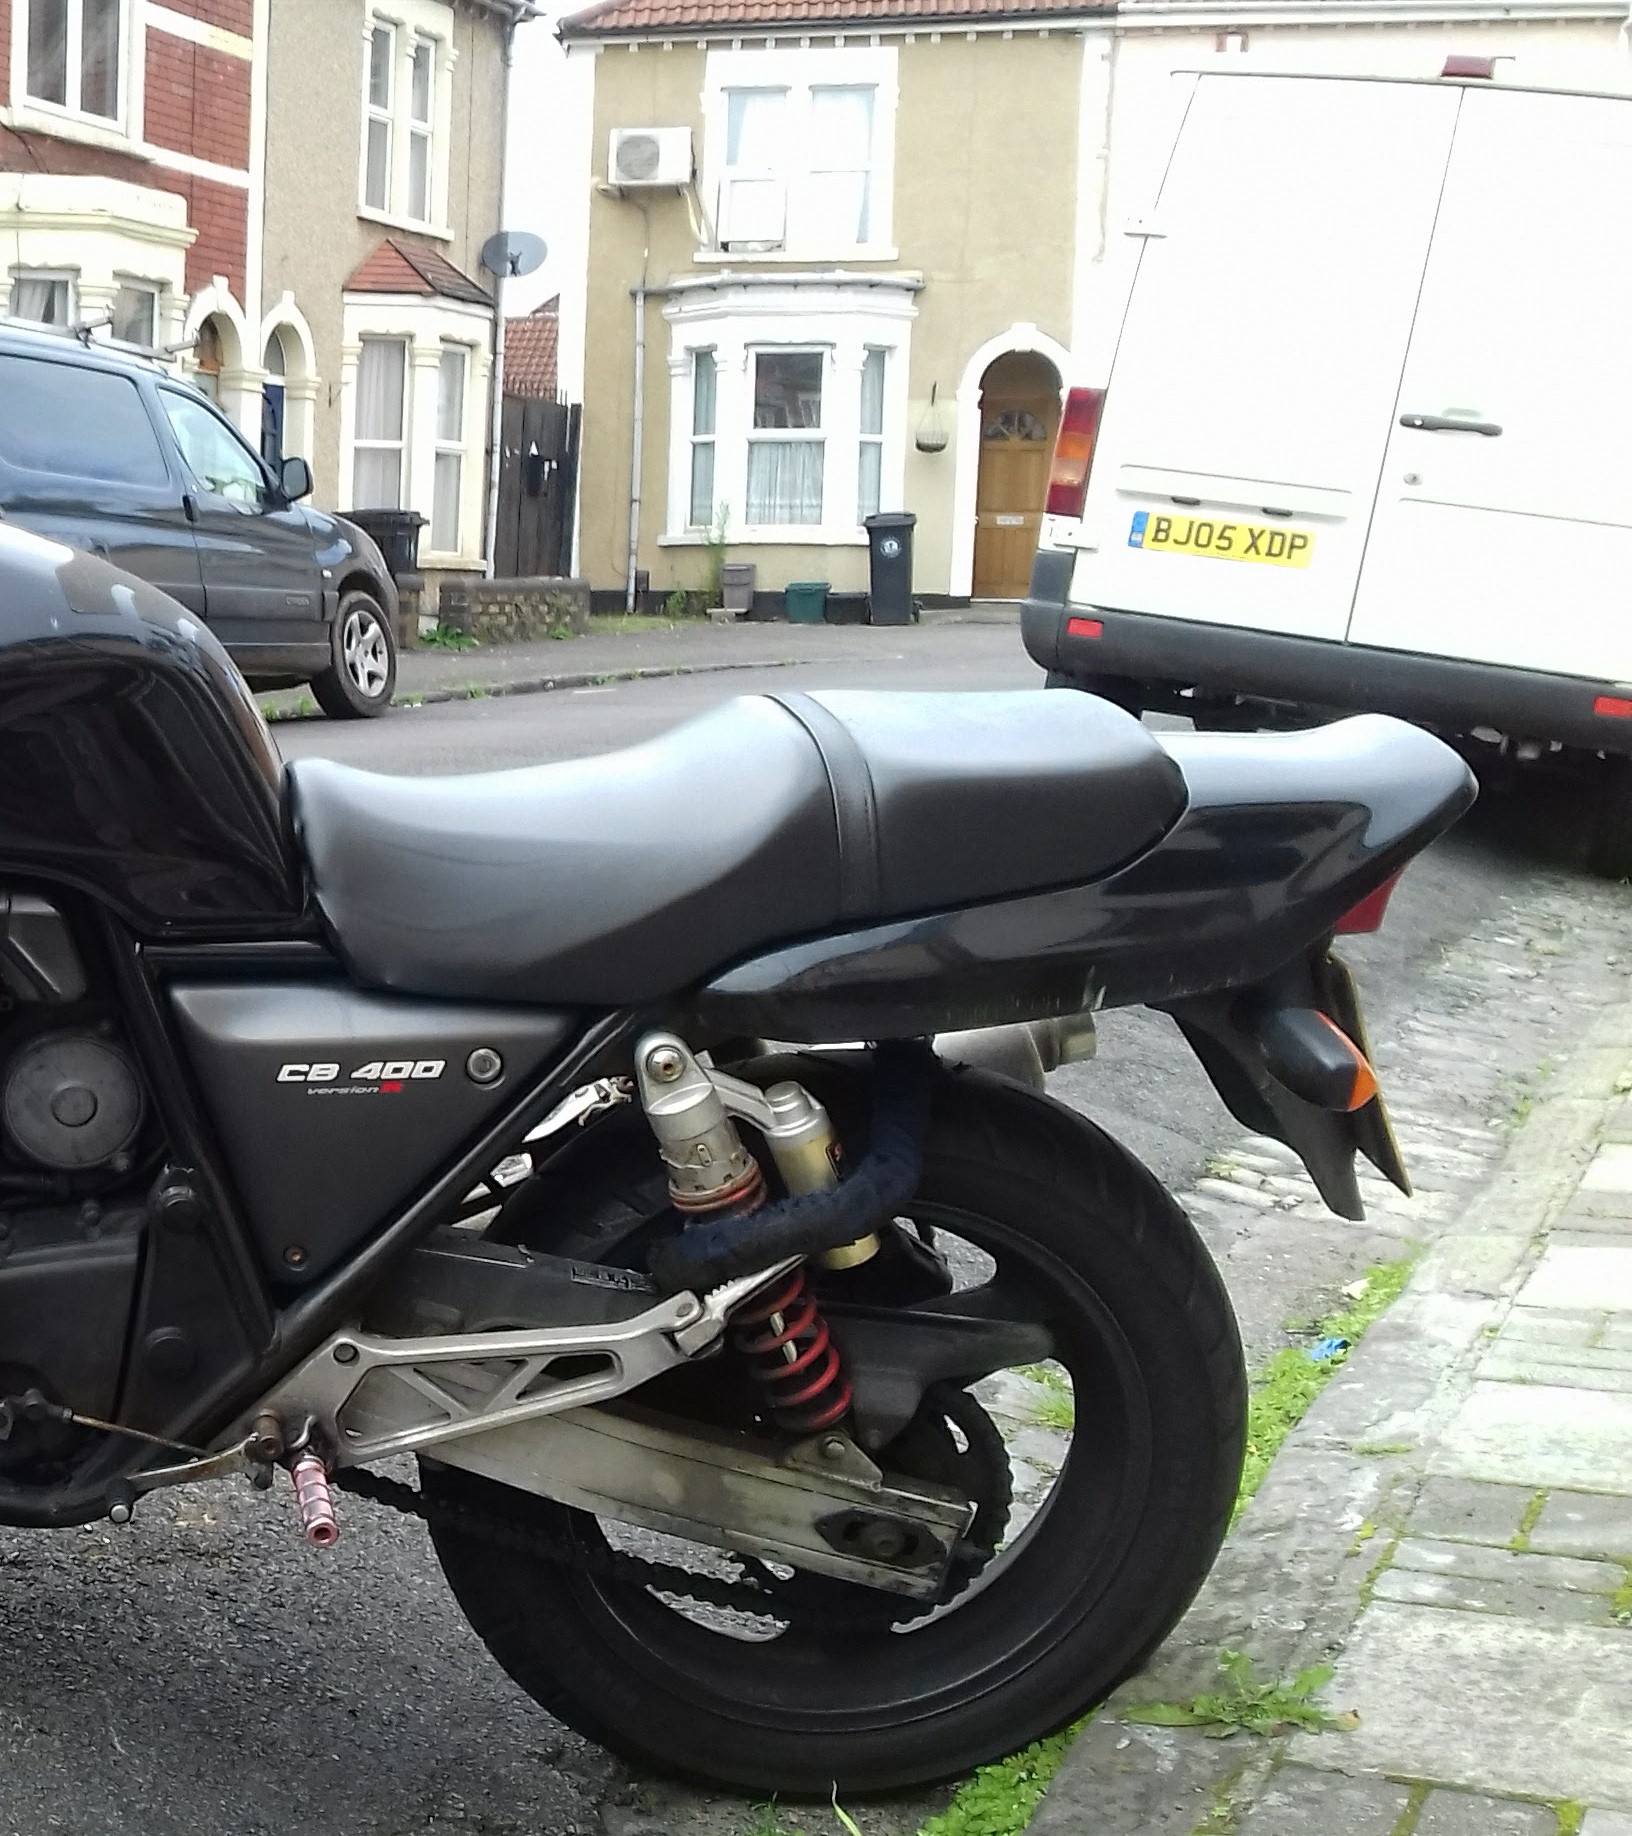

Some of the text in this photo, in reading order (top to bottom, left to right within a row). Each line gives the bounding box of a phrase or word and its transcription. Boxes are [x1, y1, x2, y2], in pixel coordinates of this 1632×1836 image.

[1151, 516, 1309, 560] BJ05 XDP
[276, 1060, 446, 1083] CB 400
[307, 1085, 379, 1096] version
